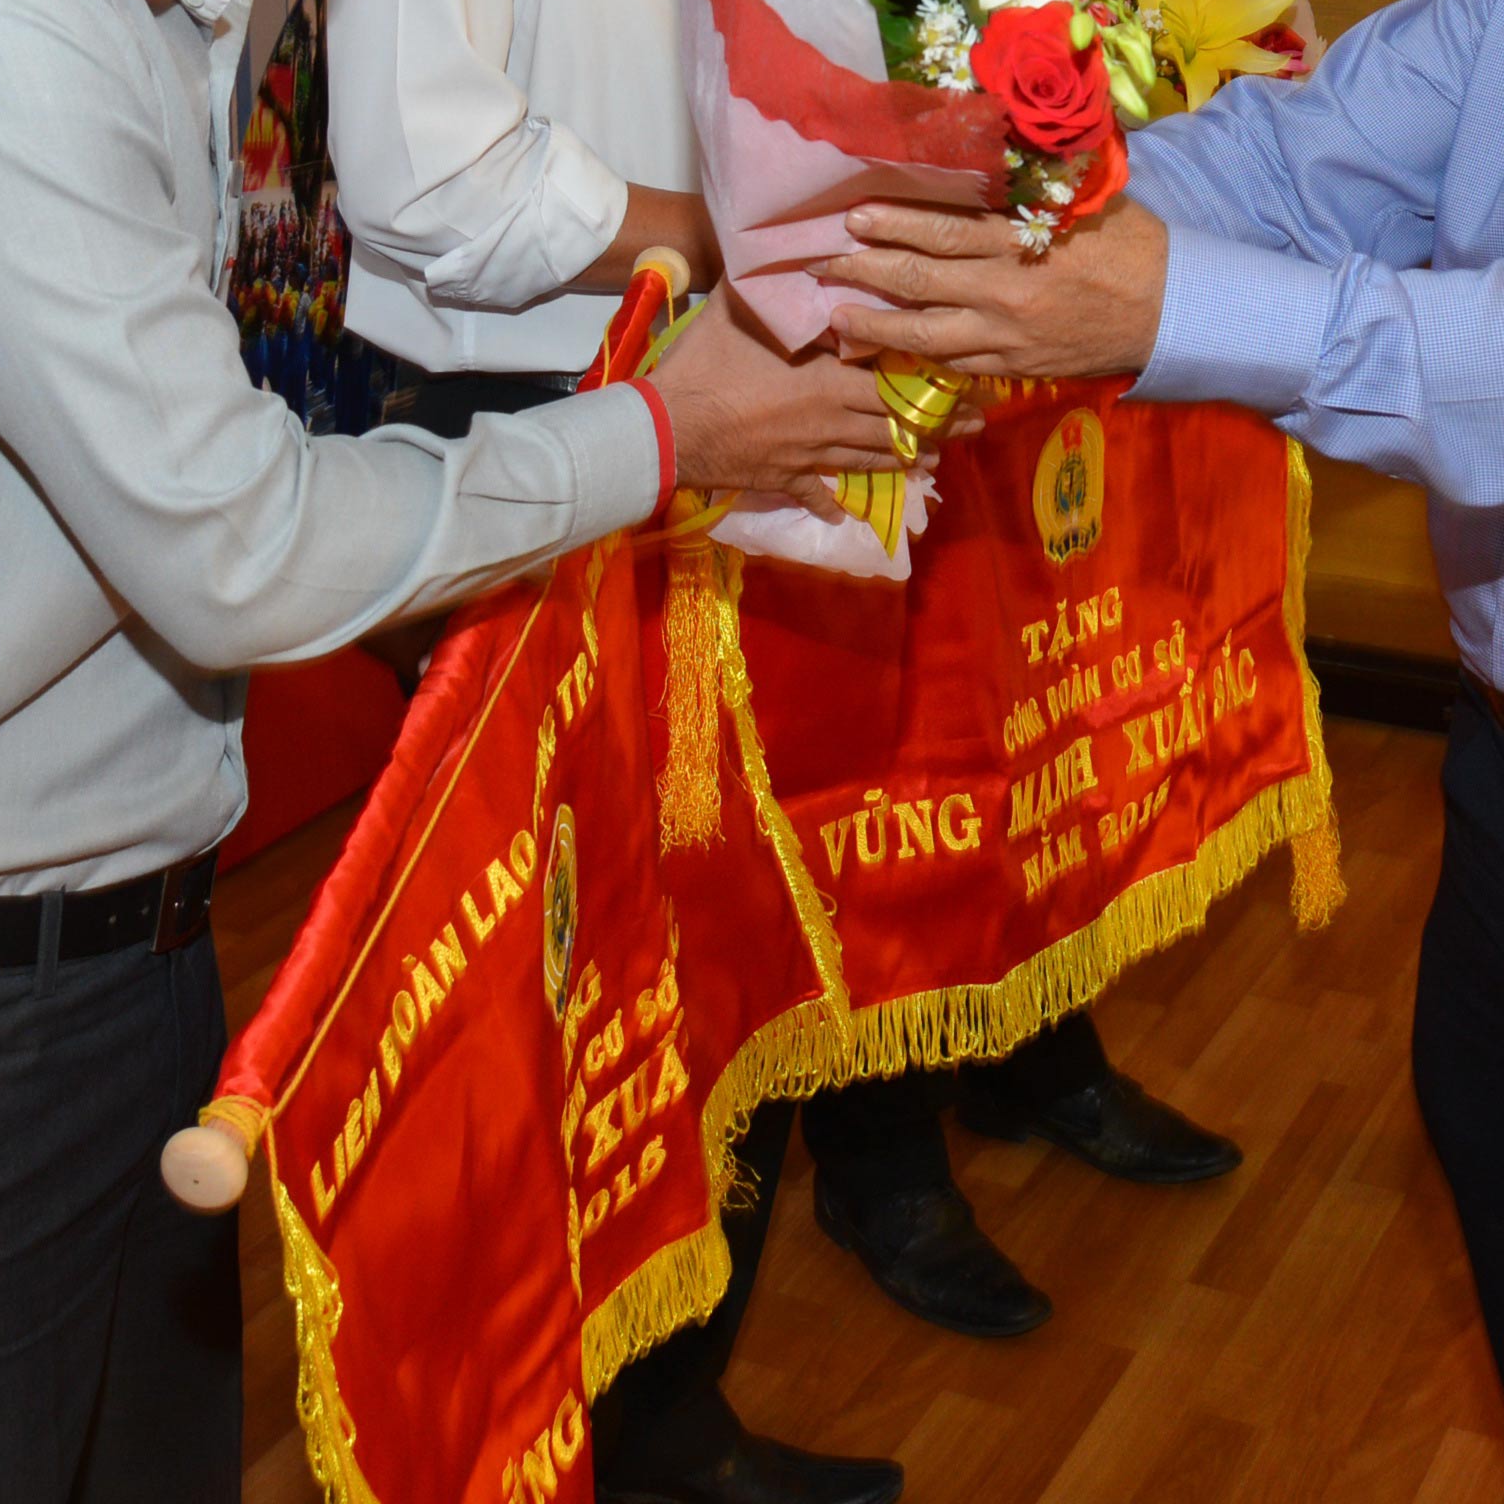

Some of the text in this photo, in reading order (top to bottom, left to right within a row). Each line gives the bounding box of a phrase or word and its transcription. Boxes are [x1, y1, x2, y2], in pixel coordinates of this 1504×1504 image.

[1021, 586, 1123, 665] TẶNG
[1004, 697, 1047, 753] CÔNG
[1111, 644, 1142, 688] CƠ
[1153, 619, 1186, 672] SỞ
[820, 788, 982, 876] VỮNG
[1007, 736, 1098, 838] MẠNH
[1022, 824, 1088, 896] NĂM
[460, 830, 538, 944] LAO
